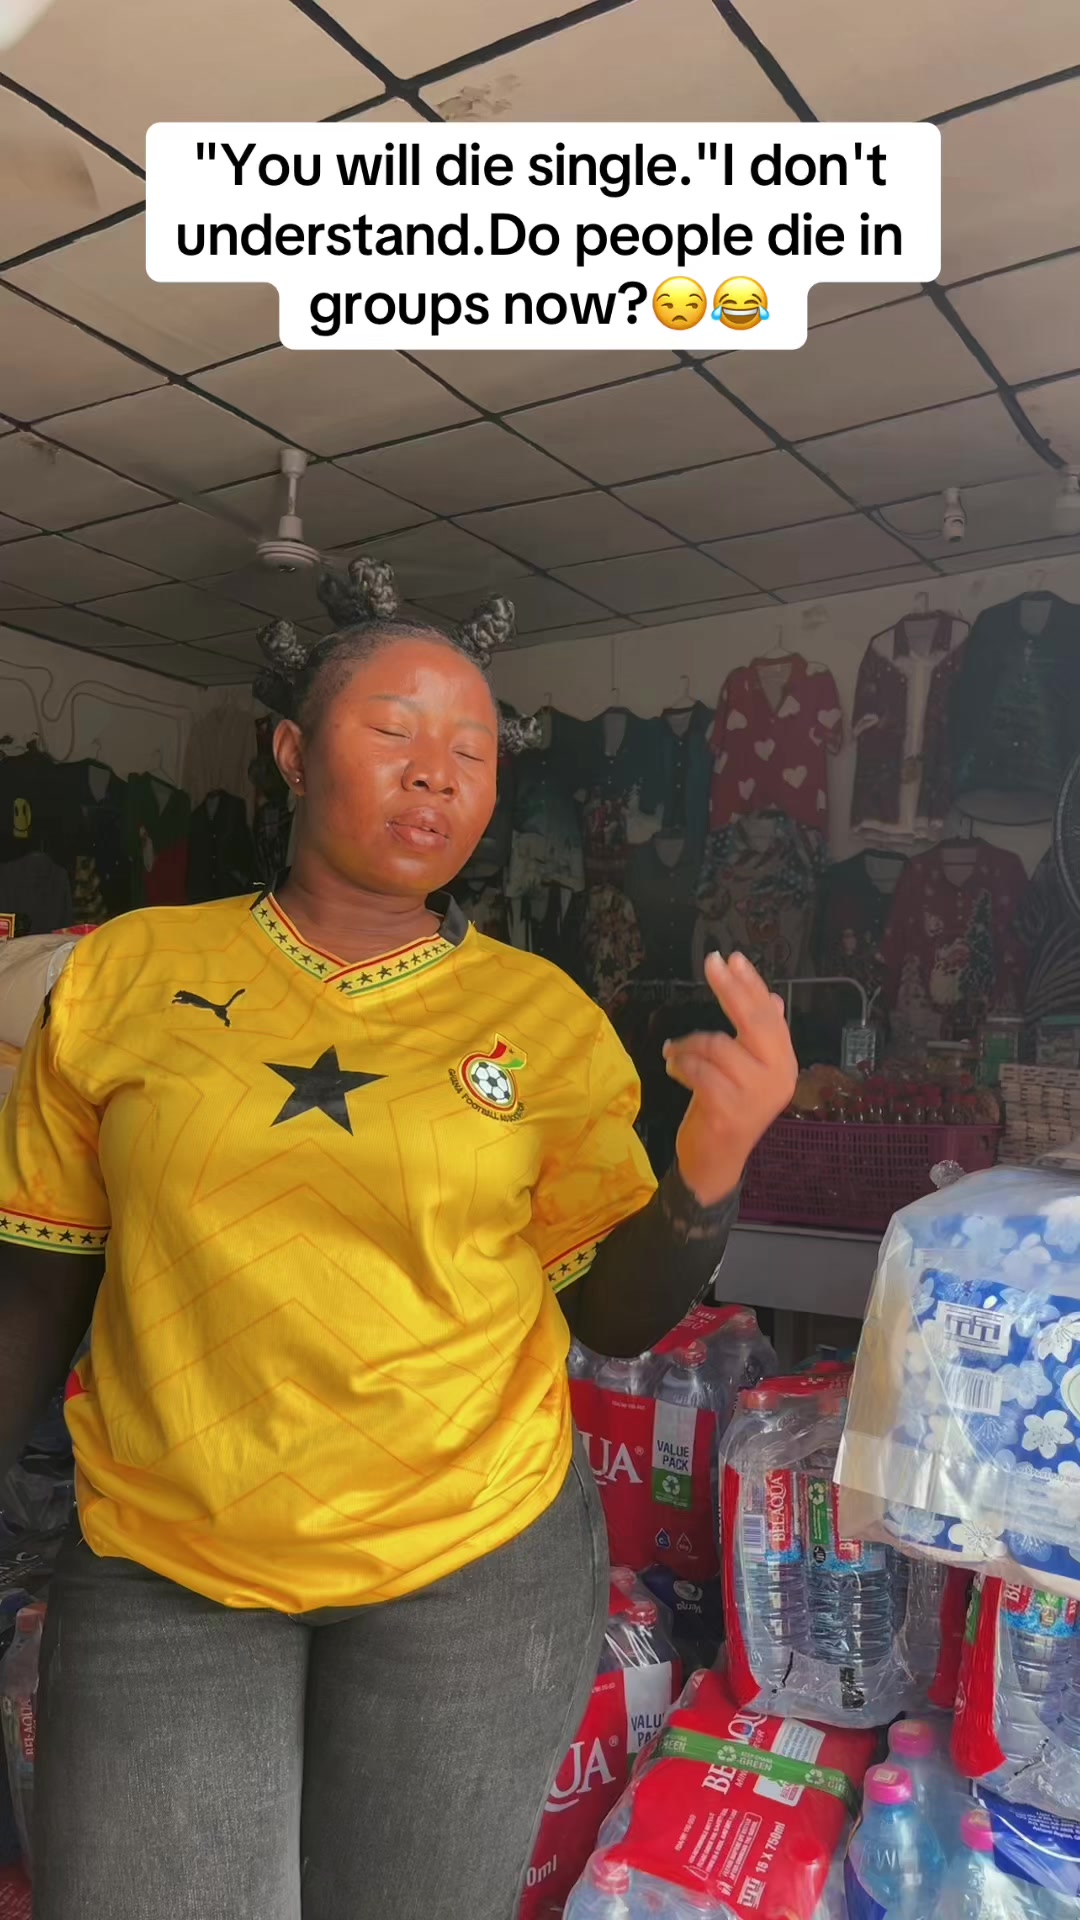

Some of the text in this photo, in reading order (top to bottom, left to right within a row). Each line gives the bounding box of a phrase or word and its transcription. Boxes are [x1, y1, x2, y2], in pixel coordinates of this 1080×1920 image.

[461, 1093, 499, 1120] FOOTBALL
[579, 1430, 643, 1485] UA
[657, 1439, 690, 1458] VALUE
[662, 1455, 689, 1472] PACK
[631, 1713, 665, 1731] VALU
[740, 1757, 773, 1772] GREEN
[764, 1821, 786, 1853] 750ml
[527, 1854, 557, 1887] 0ml
